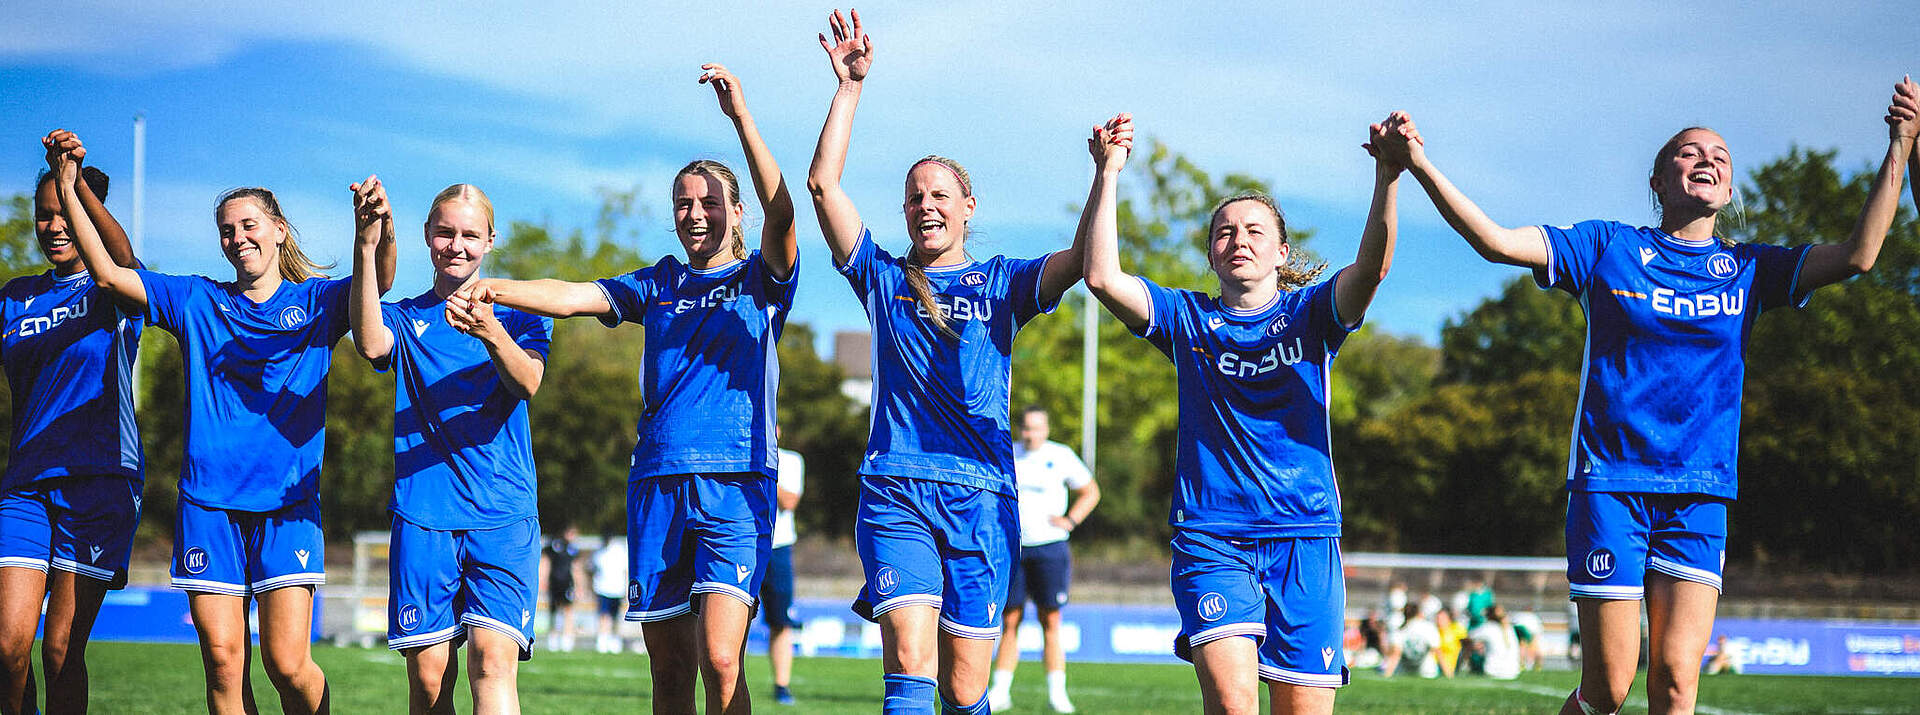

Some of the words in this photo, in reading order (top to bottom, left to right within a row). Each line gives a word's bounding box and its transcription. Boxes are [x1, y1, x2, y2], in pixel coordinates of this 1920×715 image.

[1713, 257, 1733, 275] KSC
[965, 274, 983, 286] KSC
[1652, 287, 1744, 317] EnBW
[19, 296, 88, 337] EnBW
[284, 309, 303, 328] KSC
[1271, 316, 1289, 335] KSC
[1218, 337, 1304, 377] EnBW
[189, 552, 205, 568] KSC
[1592, 553, 1611, 572] KSC
[878, 570, 895, 591] KSC
[1203, 596, 1223, 617] KSC
[403, 607, 418, 626] KSC
